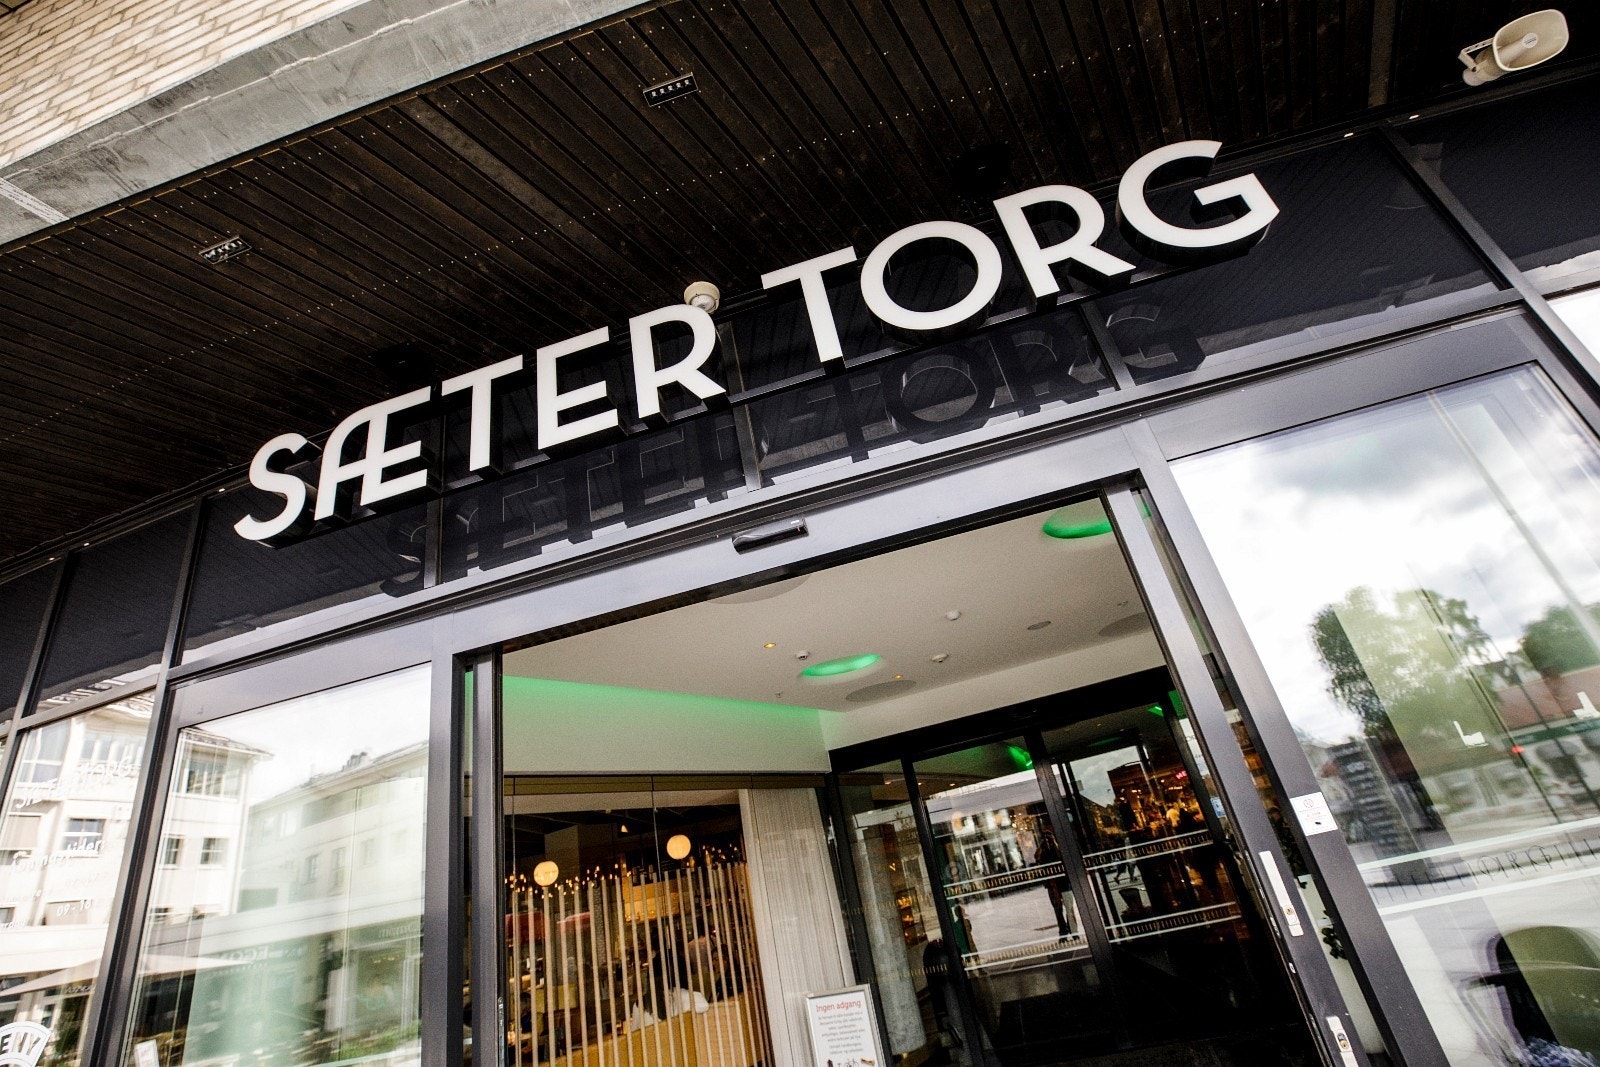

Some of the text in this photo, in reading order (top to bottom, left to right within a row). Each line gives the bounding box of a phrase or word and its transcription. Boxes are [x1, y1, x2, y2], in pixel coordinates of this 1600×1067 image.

[234, 141, 1280, 541] SÆTER TORG
[816, 1000, 862, 1013] Ingen adgang
